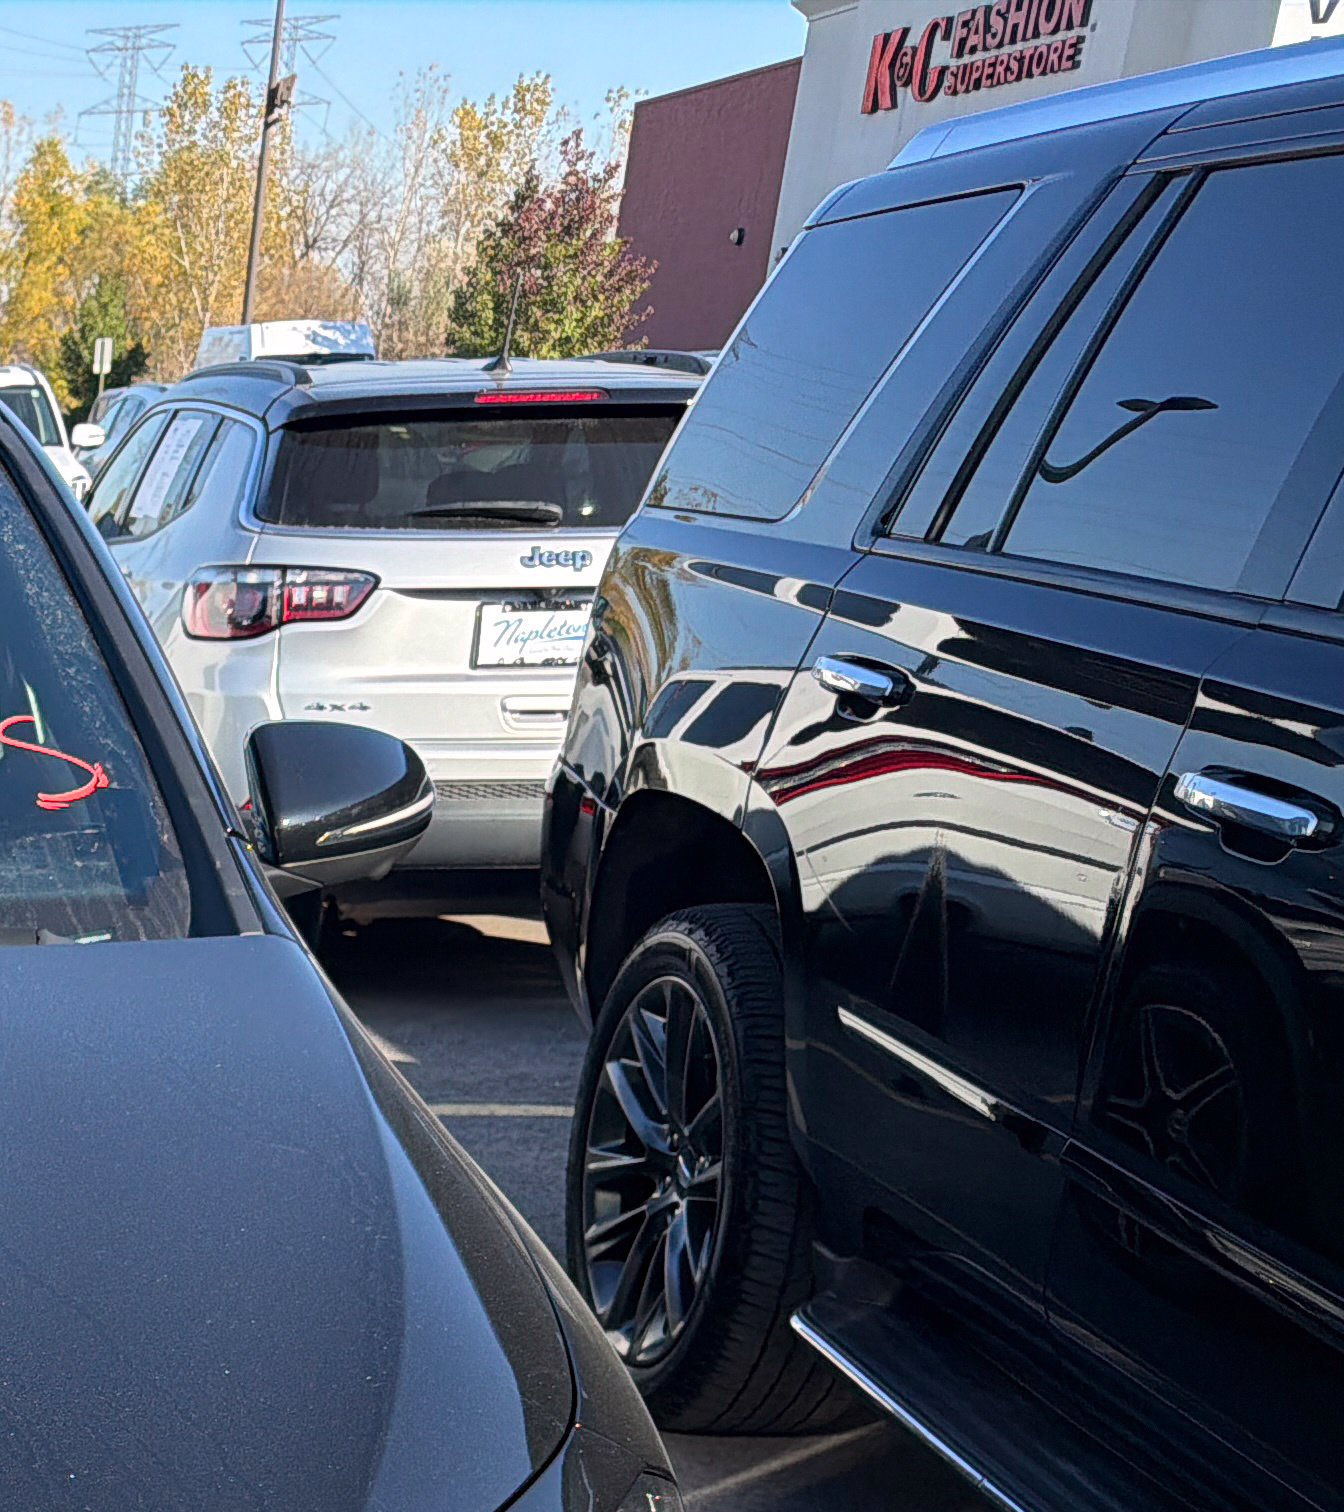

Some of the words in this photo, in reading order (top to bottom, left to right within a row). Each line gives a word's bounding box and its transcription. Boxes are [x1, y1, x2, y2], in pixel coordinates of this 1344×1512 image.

[950, 0, 1092, 59] FASHION
[944, 35, 1085, 96] SUPERSTORE
[520, 546, 593, 572] Jeep
[493, 611, 588, 654] Napleto
